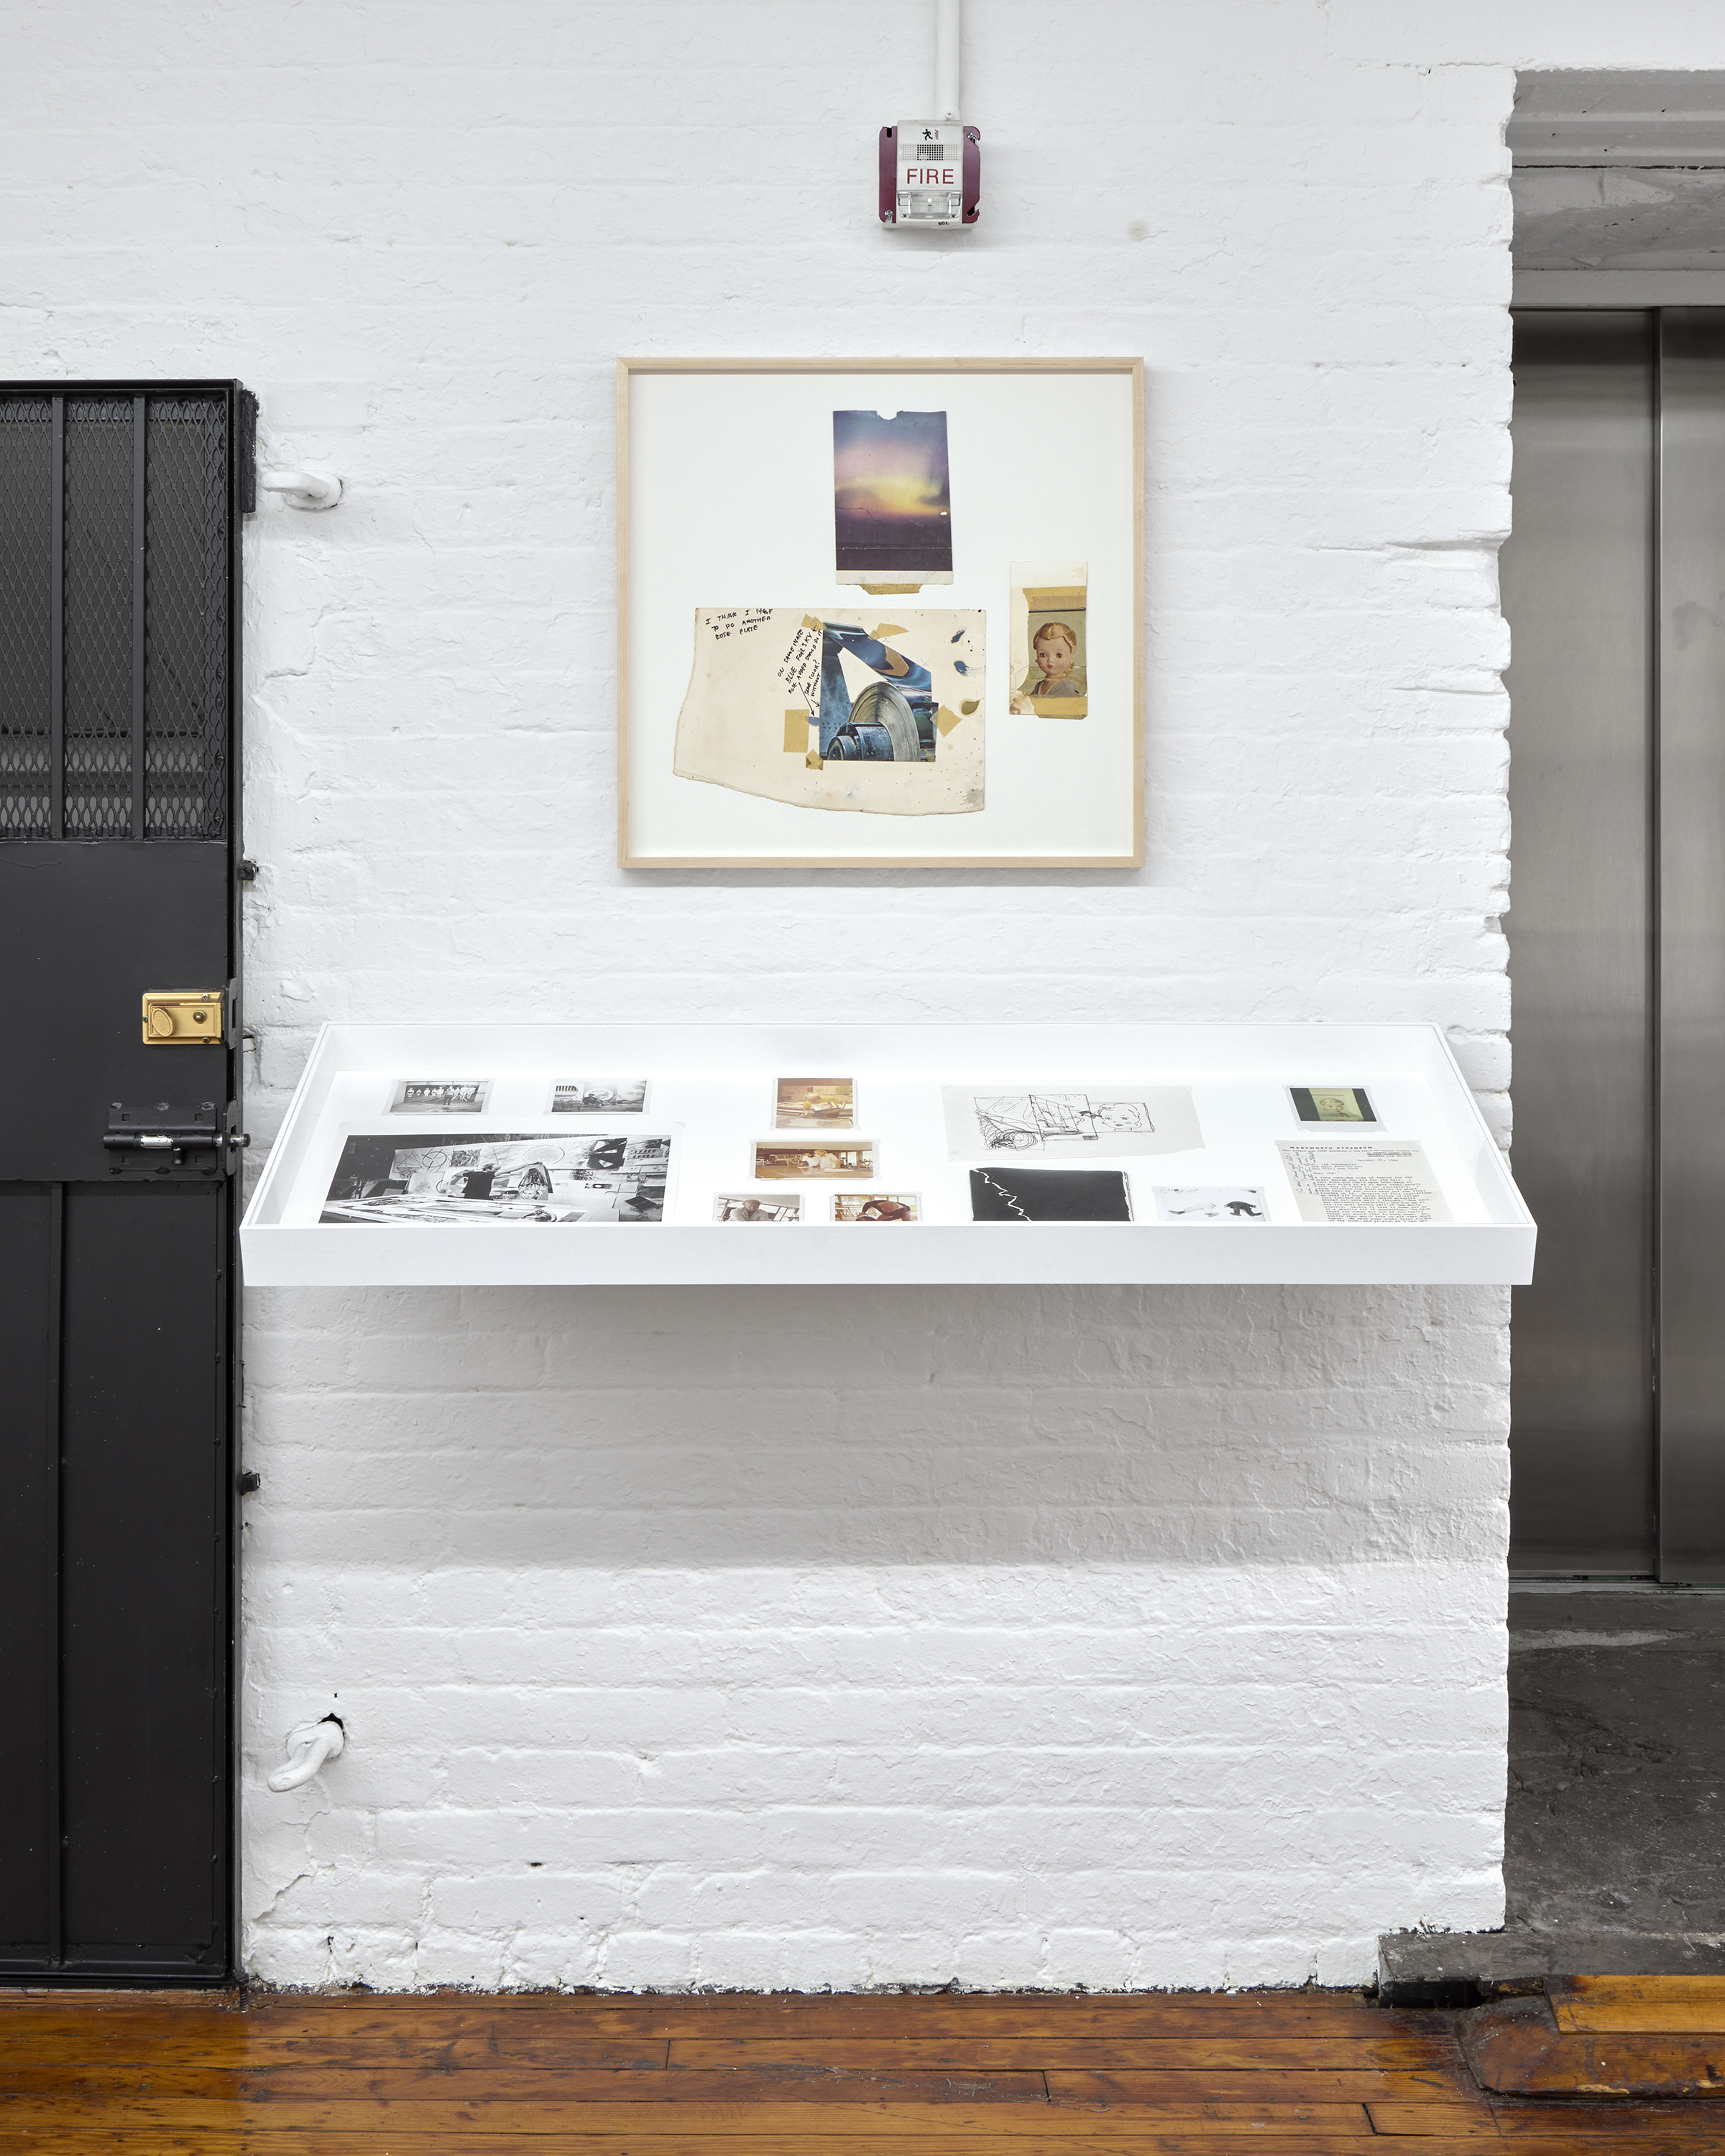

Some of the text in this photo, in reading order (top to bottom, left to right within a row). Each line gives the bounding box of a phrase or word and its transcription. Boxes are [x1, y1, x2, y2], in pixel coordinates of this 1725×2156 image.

[907, 168, 954, 185] FIRE
[717, 612, 737, 622] THINK
[742, 615, 771, 625] ANOTHER
[715, 631, 732, 640] ROSE
[785, 665, 798, 685] BLUE
[801, 632, 813, 648] SKY
[777, 666, 785, 678] ON
